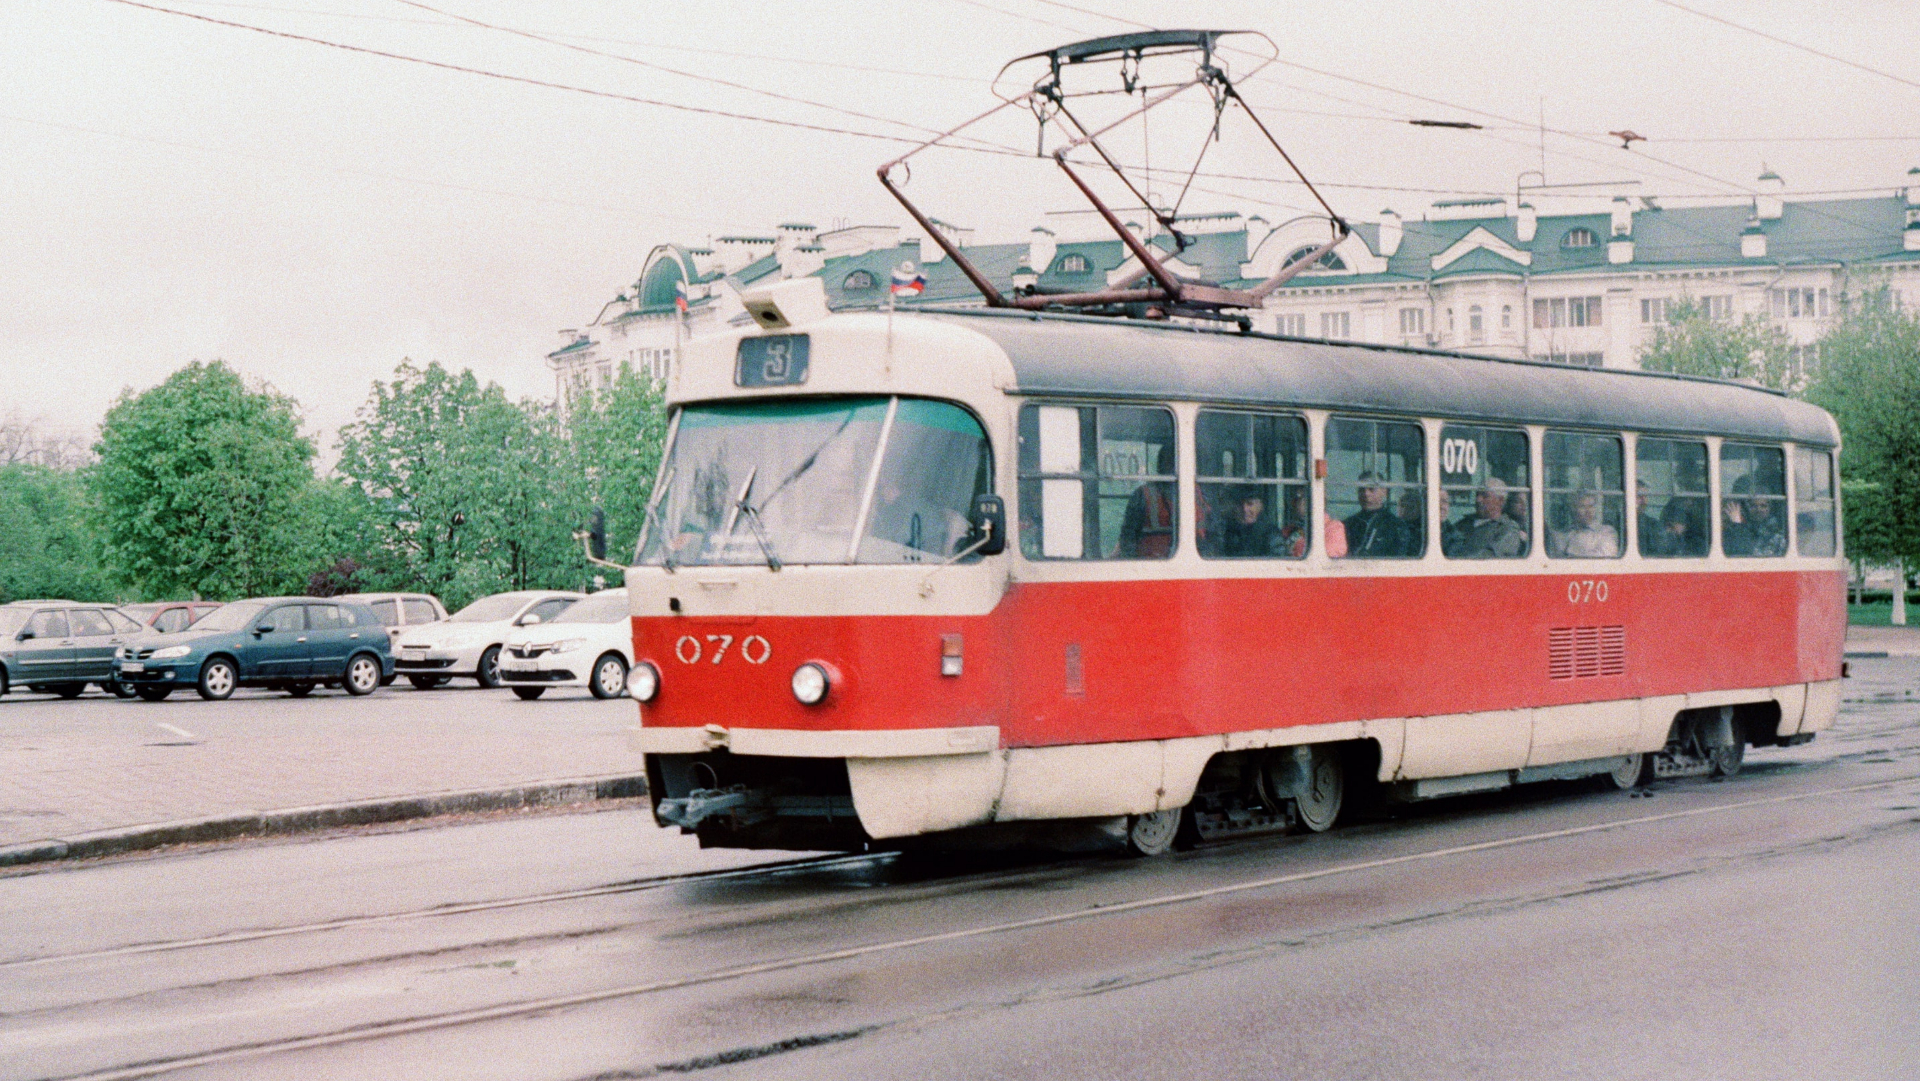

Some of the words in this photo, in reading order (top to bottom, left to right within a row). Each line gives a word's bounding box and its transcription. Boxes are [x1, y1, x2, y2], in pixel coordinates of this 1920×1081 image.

[763, 338, 793, 381] 3
[1443, 438, 1478, 475] 070
[1568, 580, 1609, 603] 070
[675, 634, 772, 665] 070
